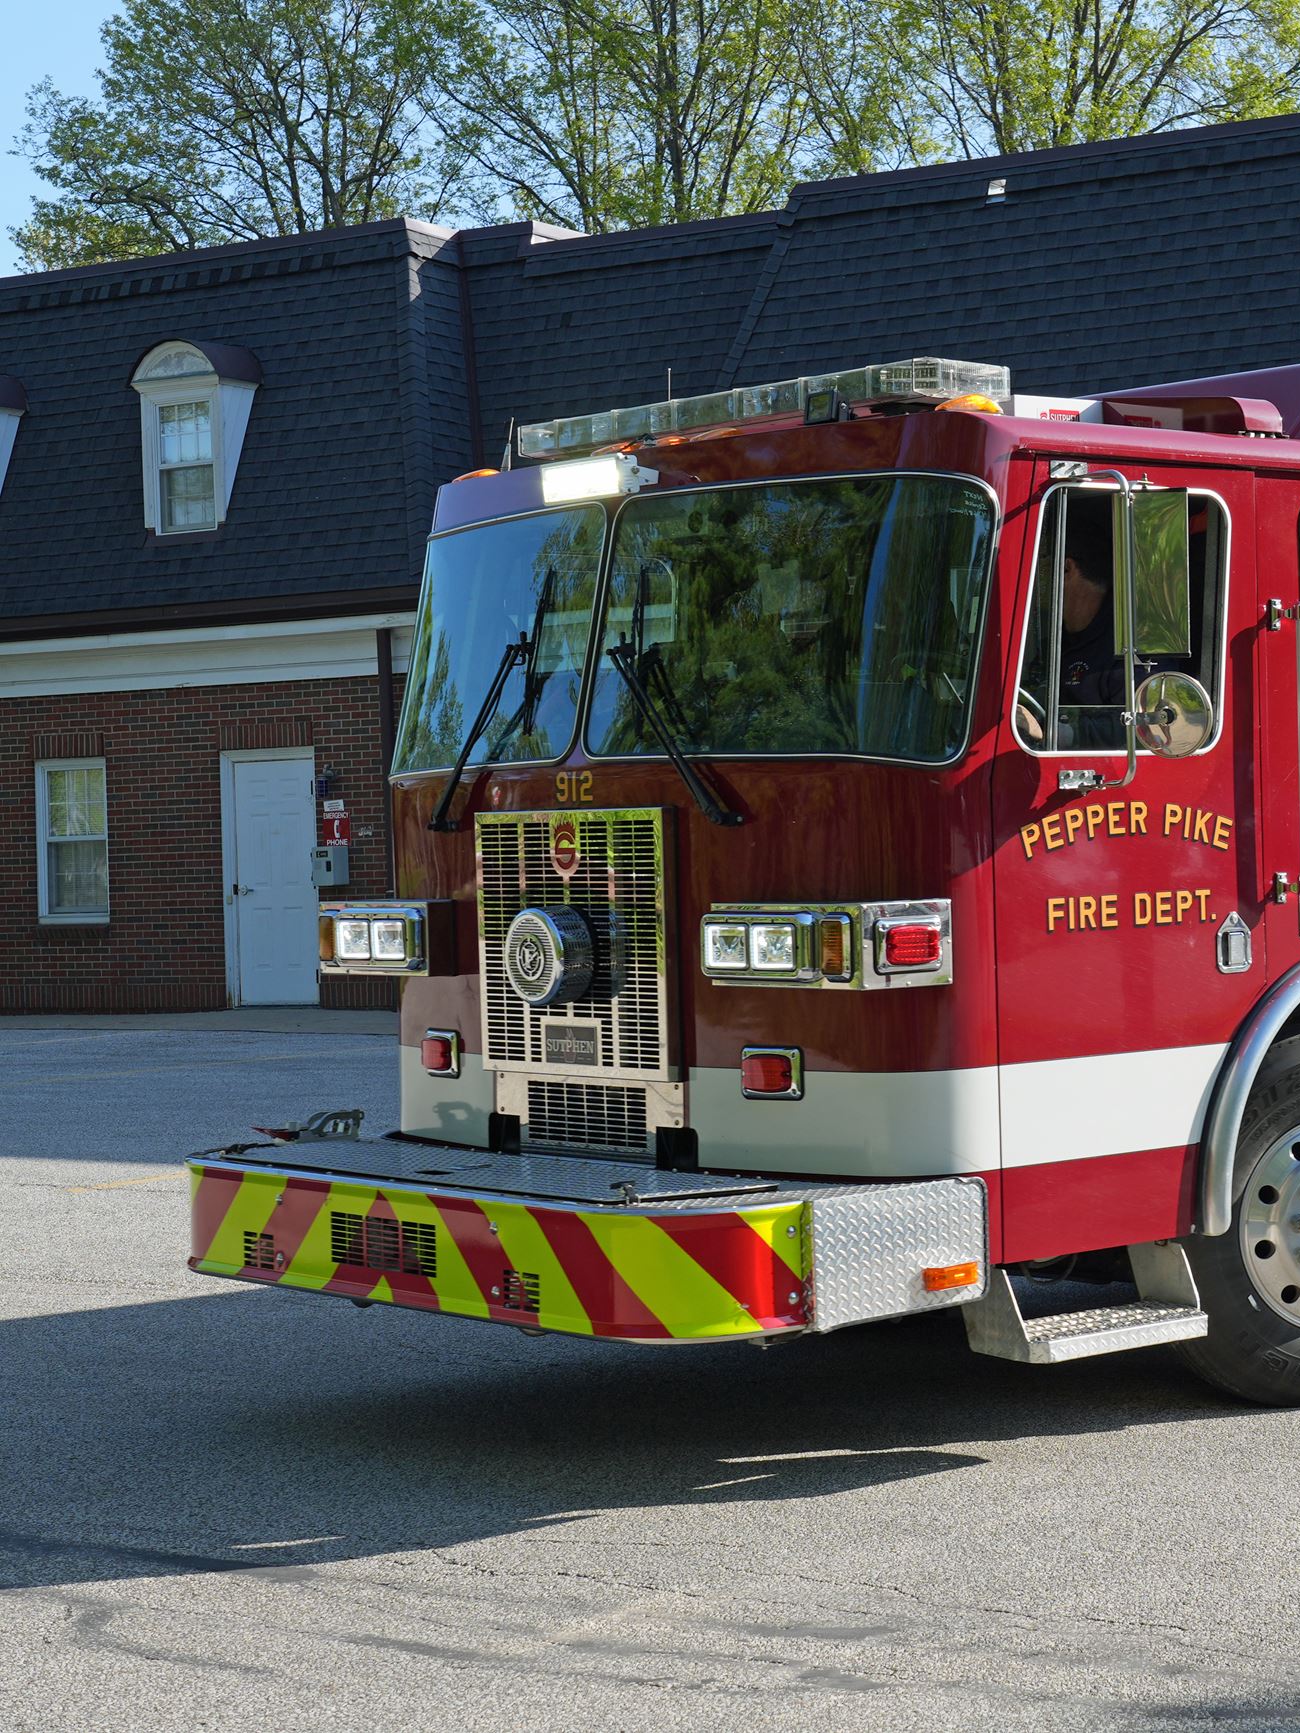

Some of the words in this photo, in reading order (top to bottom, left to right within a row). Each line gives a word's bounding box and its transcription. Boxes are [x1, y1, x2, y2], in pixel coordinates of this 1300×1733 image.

[556, 770, 593, 802] 912
[1020, 801, 1148, 859] PEPPER
[1163, 803, 1233, 850] PIKE
[1047, 894, 1119, 932] FIRE
[1134, 889, 1217, 926] DEPT.
[546, 1038, 594, 1055] SUTPHEN
